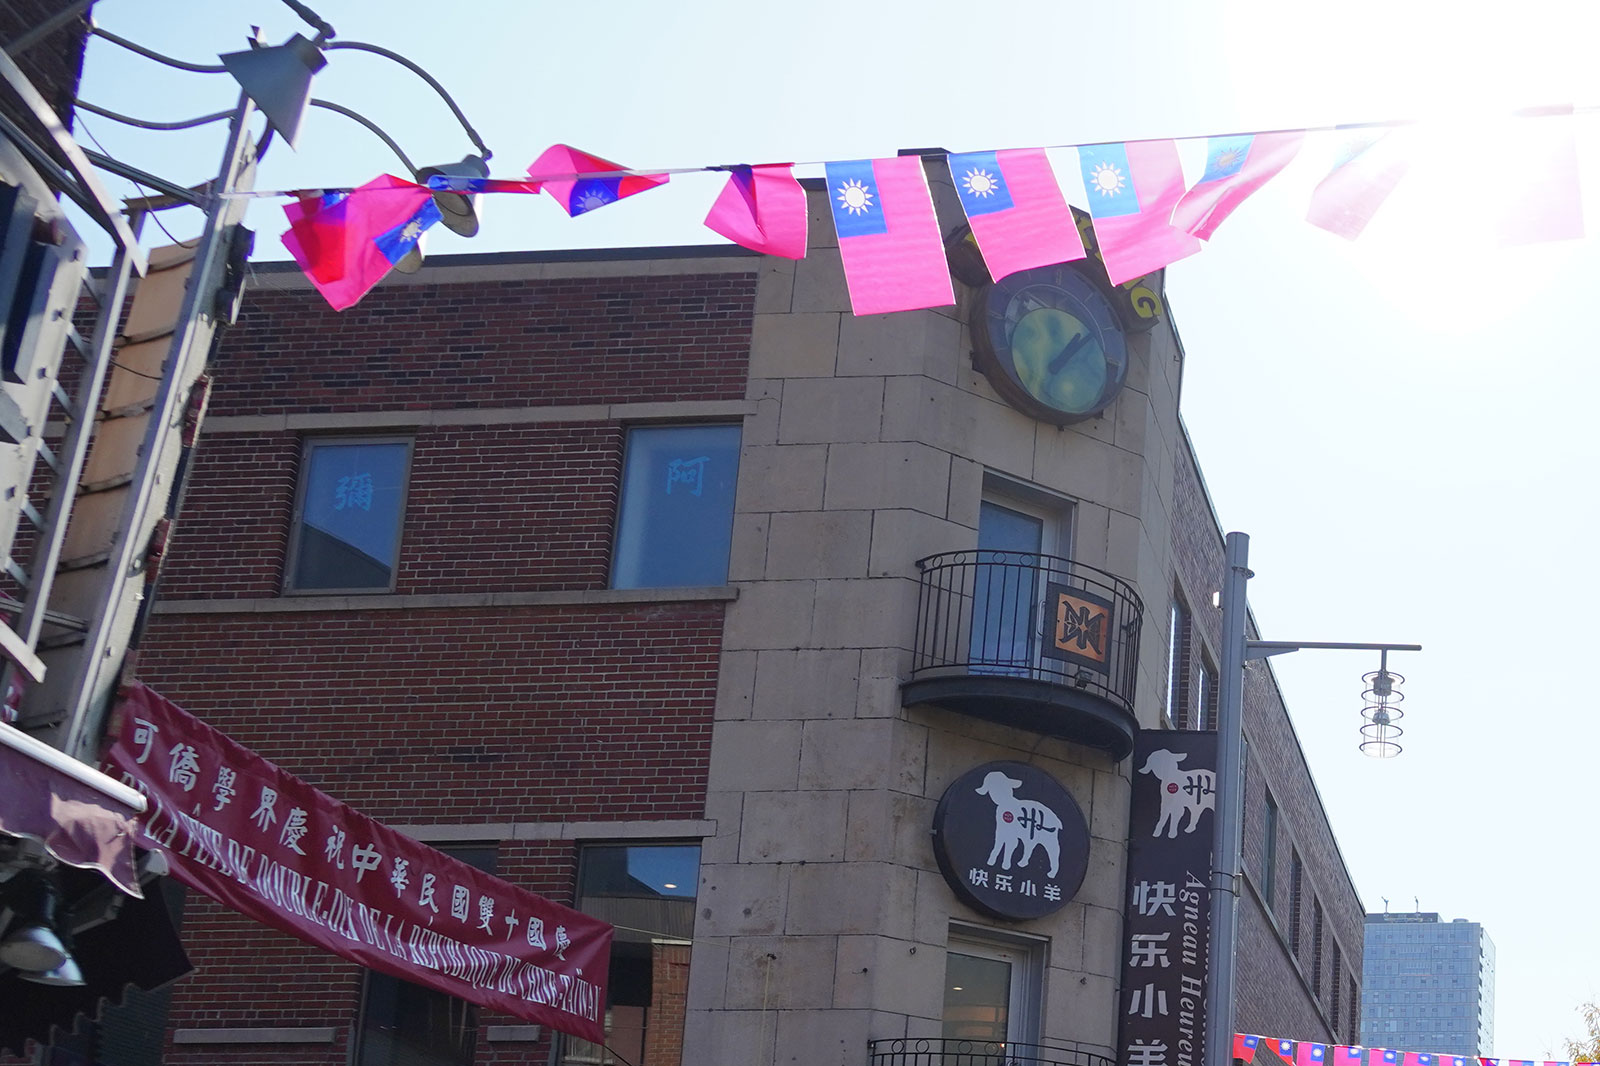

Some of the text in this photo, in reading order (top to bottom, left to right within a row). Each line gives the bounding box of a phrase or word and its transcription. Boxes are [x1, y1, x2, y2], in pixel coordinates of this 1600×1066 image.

[666, 455, 711, 497] 阿
[968, 868, 1061, 902] 快乐小羊
[1181, 870, 1206, 966] Agneau
[228, 838, 258, 892] DE
[256, 853, 360, 942] DOUBLE-DIX
[358, 902, 386, 951] DE
[384, 914, 408, 961] LA
[409, 915, 502, 989] RÉPUBLIQUE
[499, 954, 521, 996] DE
[518, 961, 602, 1024] CHINE-TAÏWAN
